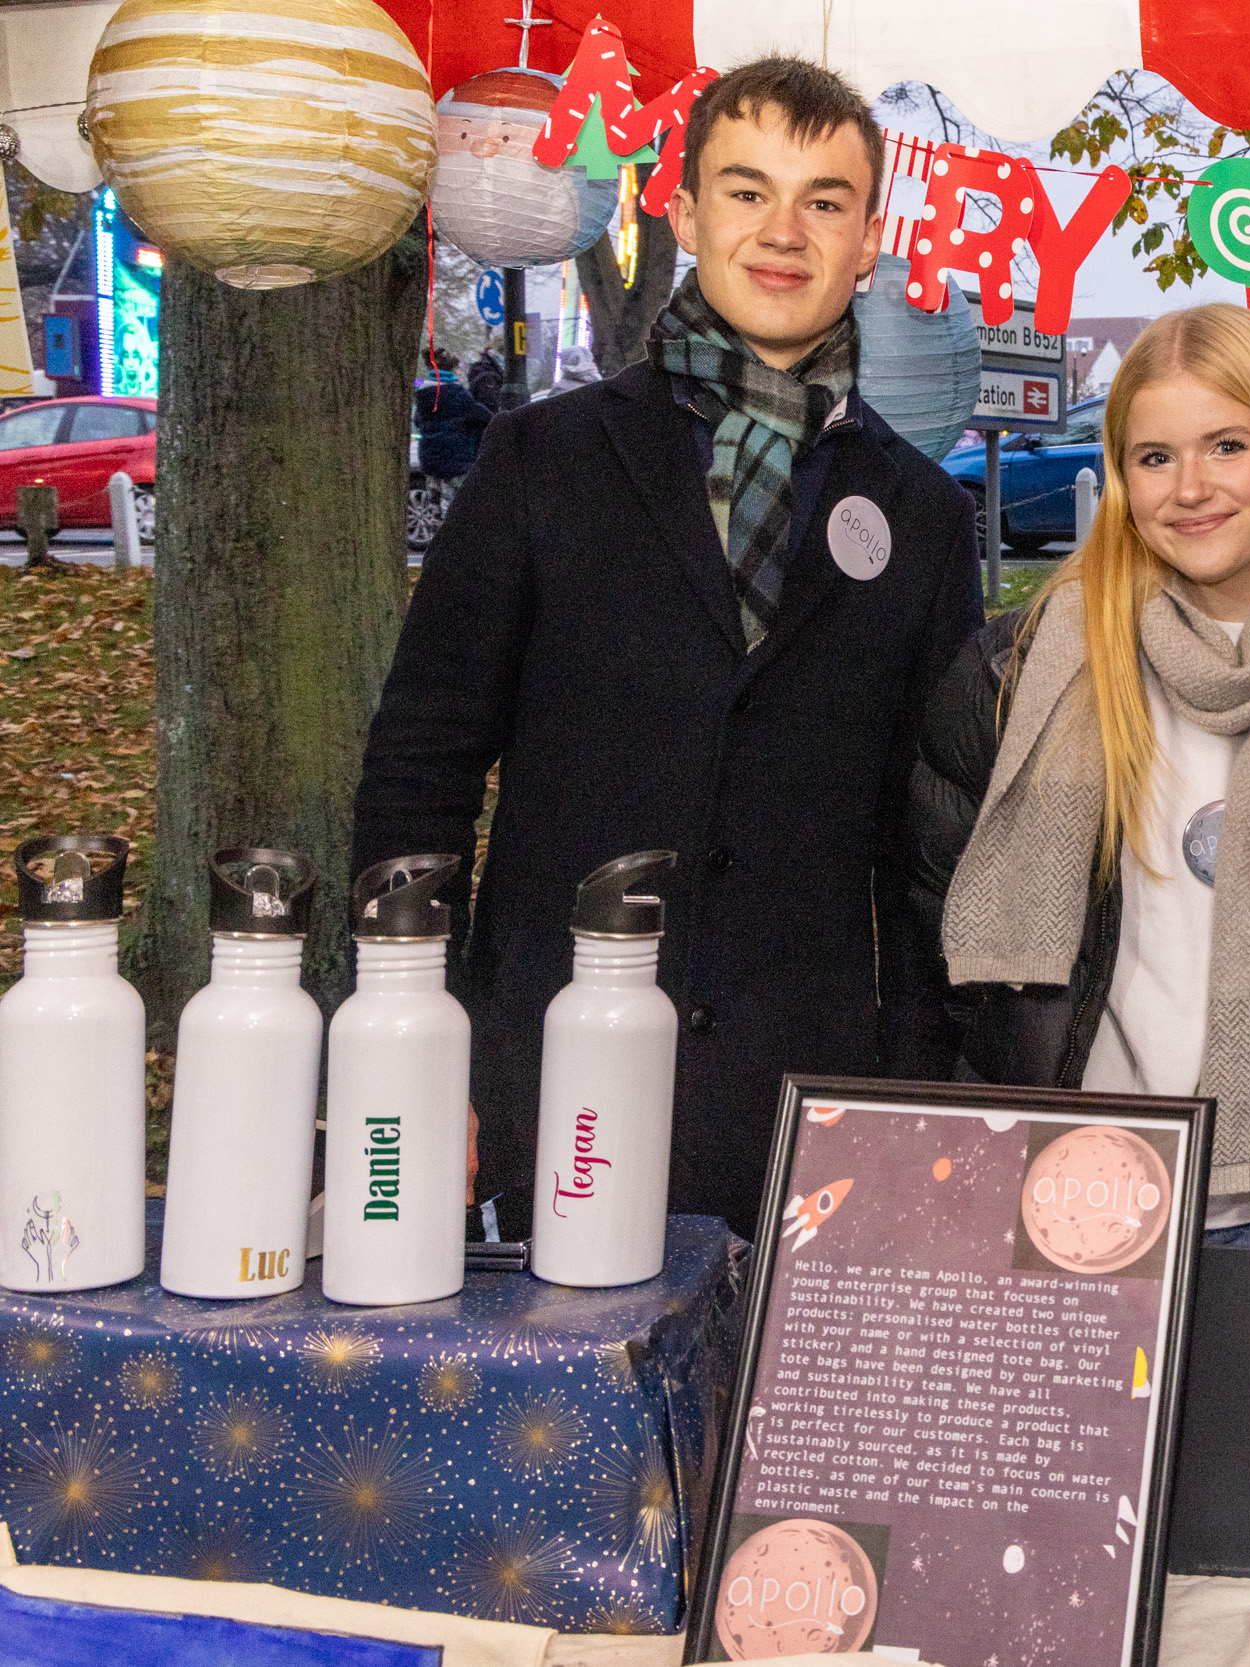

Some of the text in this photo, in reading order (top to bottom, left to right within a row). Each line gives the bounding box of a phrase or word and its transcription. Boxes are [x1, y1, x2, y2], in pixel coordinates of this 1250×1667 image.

[977, 326, 1058, 350] mpton B652
[977, 384, 1016, 406] tation
[841, 508, 887, 561] apollo
[364, 1116, 401, 1222] Daniel
[553, 1107, 612, 1218] Tegan
[1034, 1177, 1160, 1211] apollo
[237, 1247, 290, 1282] Luc
[847, 1266, 862, 1275] we
[870, 1268, 891, 1276] are
[901, 1268, 930, 1279] team
[998, 1277, 1012, 1285] an
[1020, 1278, 1118, 1296] award-winning
[792, 1278, 1078, 1305] young enterprise group that focuses on
[787, 1308, 1119, 1340] products: personalised water bottles (either
[791, 1292, 1107, 1325] sustainability. We have created two unique
[783, 1338, 1100, 1371] sticker) and hand designed tote bag. Our
[785, 1322, 1109, 1358] with your name with selection of vinyl
[777, 1370, 1049, 1399] and sustainability team. We have all
[781, 1353, 1123, 1392] tote bags have been designed by our marketing
[774, 1386, 995, 1411] contributed into making these
[771, 1416, 1083, 1453] is perfect for our customers. Each bag is
[772, 1402, 1108, 1437] working tirelessly to produce product that
[764, 1450, 1111, 1485] recycled cotton. We decided to focus on water
[767, 1434, 1050, 1468] sustainably as is made by
[757, 1480, 1028, 1513] plastic waste and the impact on the
[830, 1472, 1109, 1502] as one of our team's main concern is
[755, 1499, 844, 1514] environment.
[728, 1576, 866, 1616] apollo
